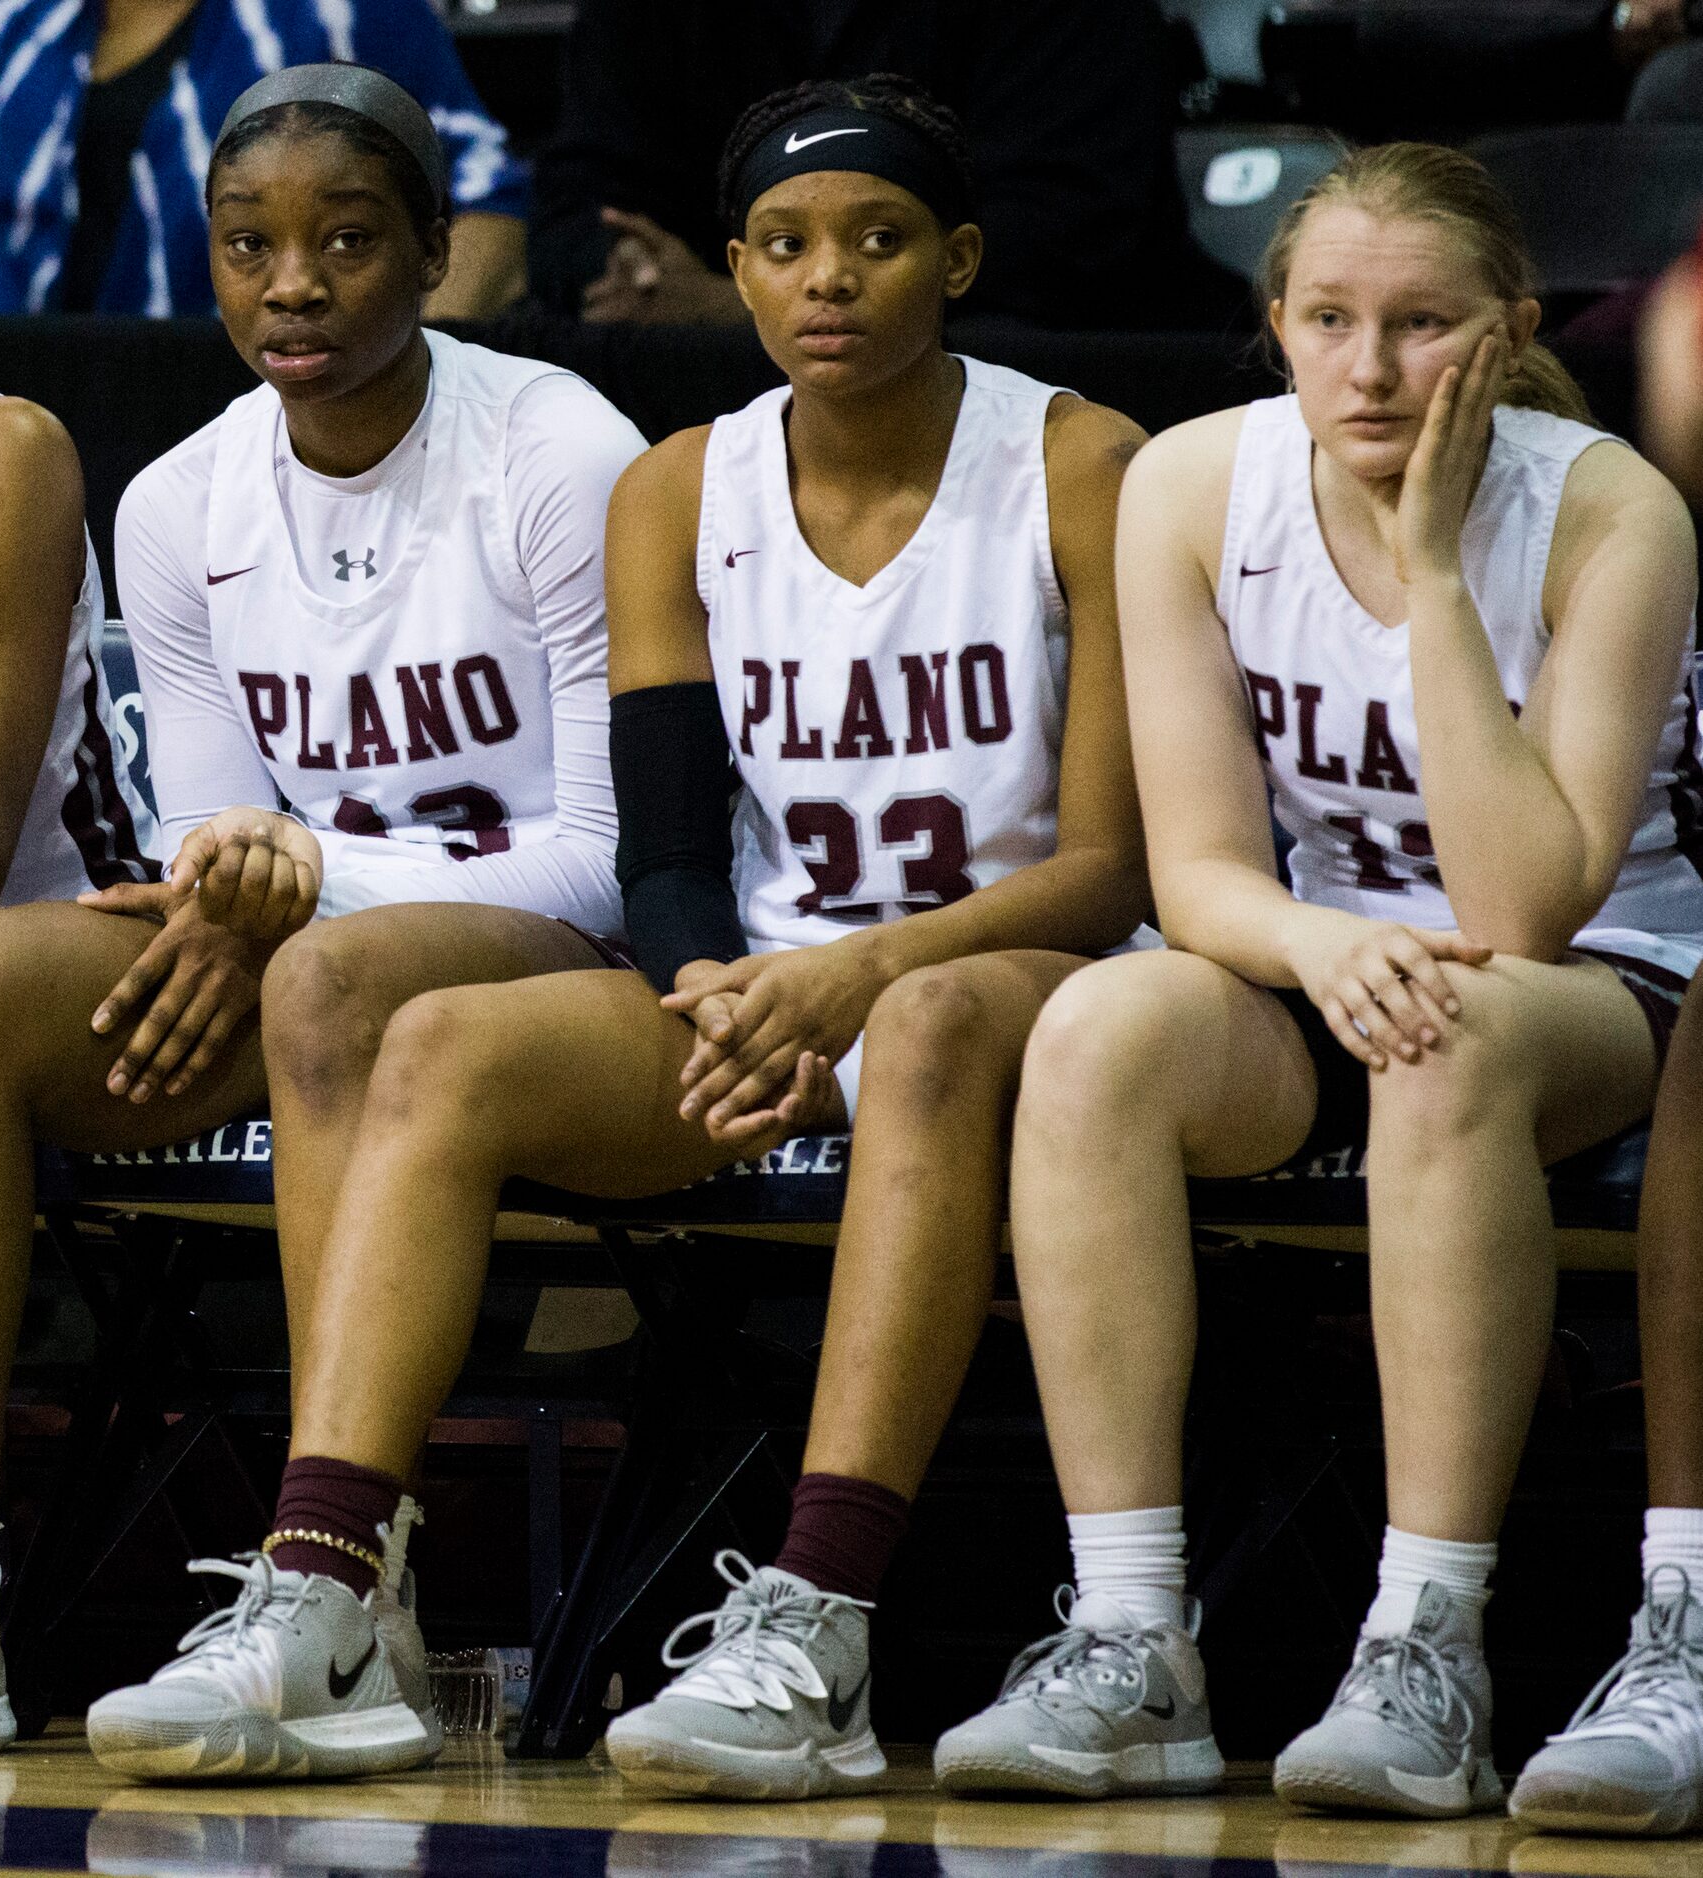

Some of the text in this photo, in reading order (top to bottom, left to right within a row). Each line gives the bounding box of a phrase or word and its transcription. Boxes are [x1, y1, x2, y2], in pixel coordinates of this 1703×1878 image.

[237, 651, 521, 771] PLANO
[738, 639, 1014, 762] PLANO
[781, 786, 981, 924] 23
